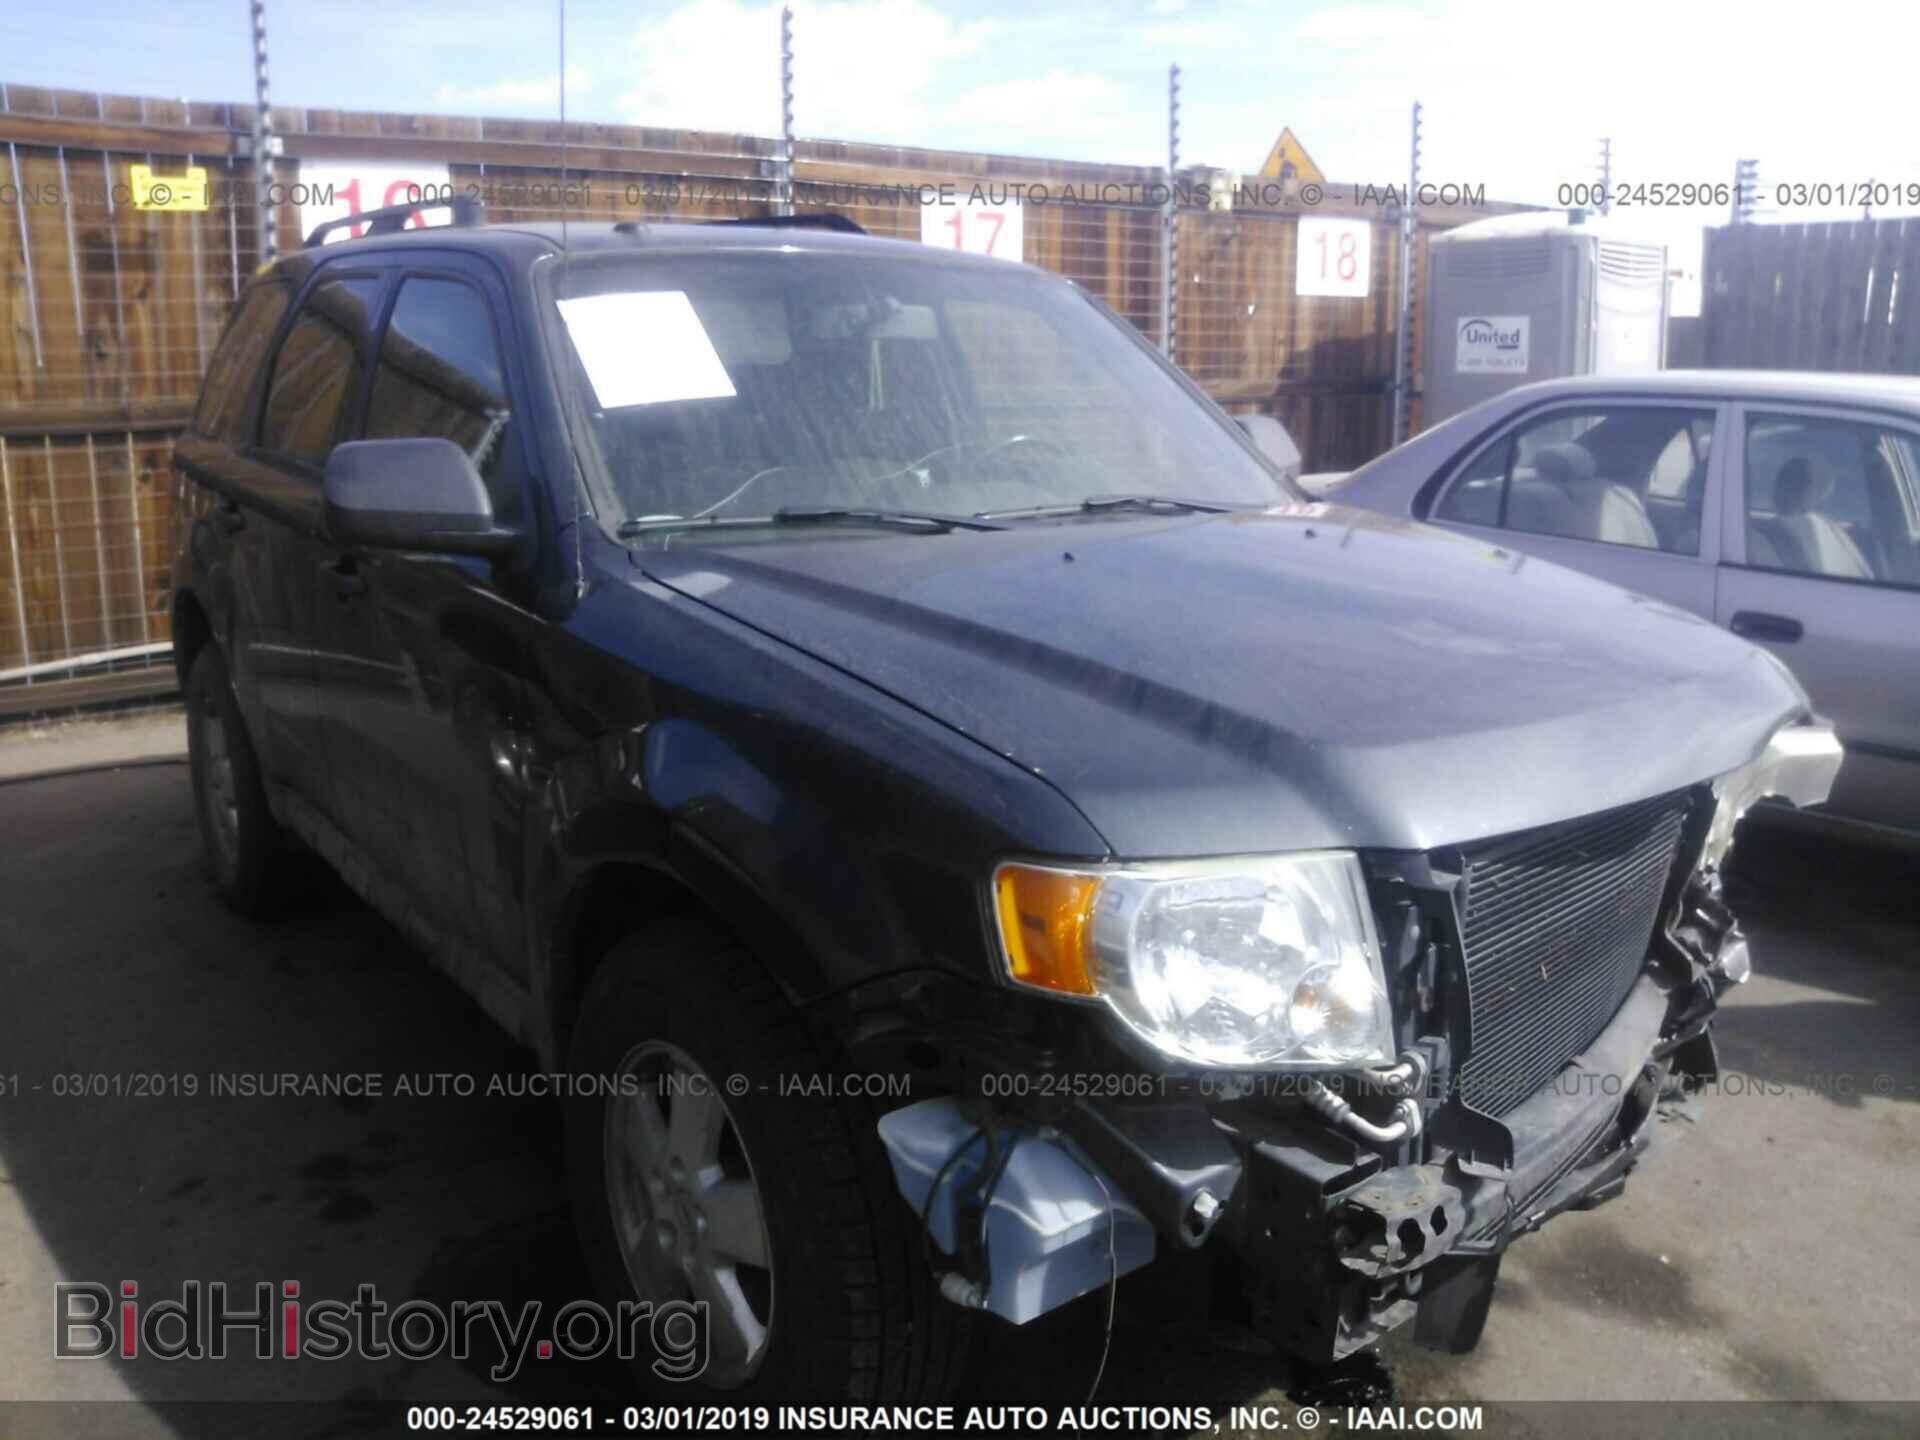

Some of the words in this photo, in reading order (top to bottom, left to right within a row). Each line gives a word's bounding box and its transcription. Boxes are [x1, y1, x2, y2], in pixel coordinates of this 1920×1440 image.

[944, 209, 1006, 255] 17
[1313, 230, 1358, 283] 18
[1466, 327, 1521, 344] United
